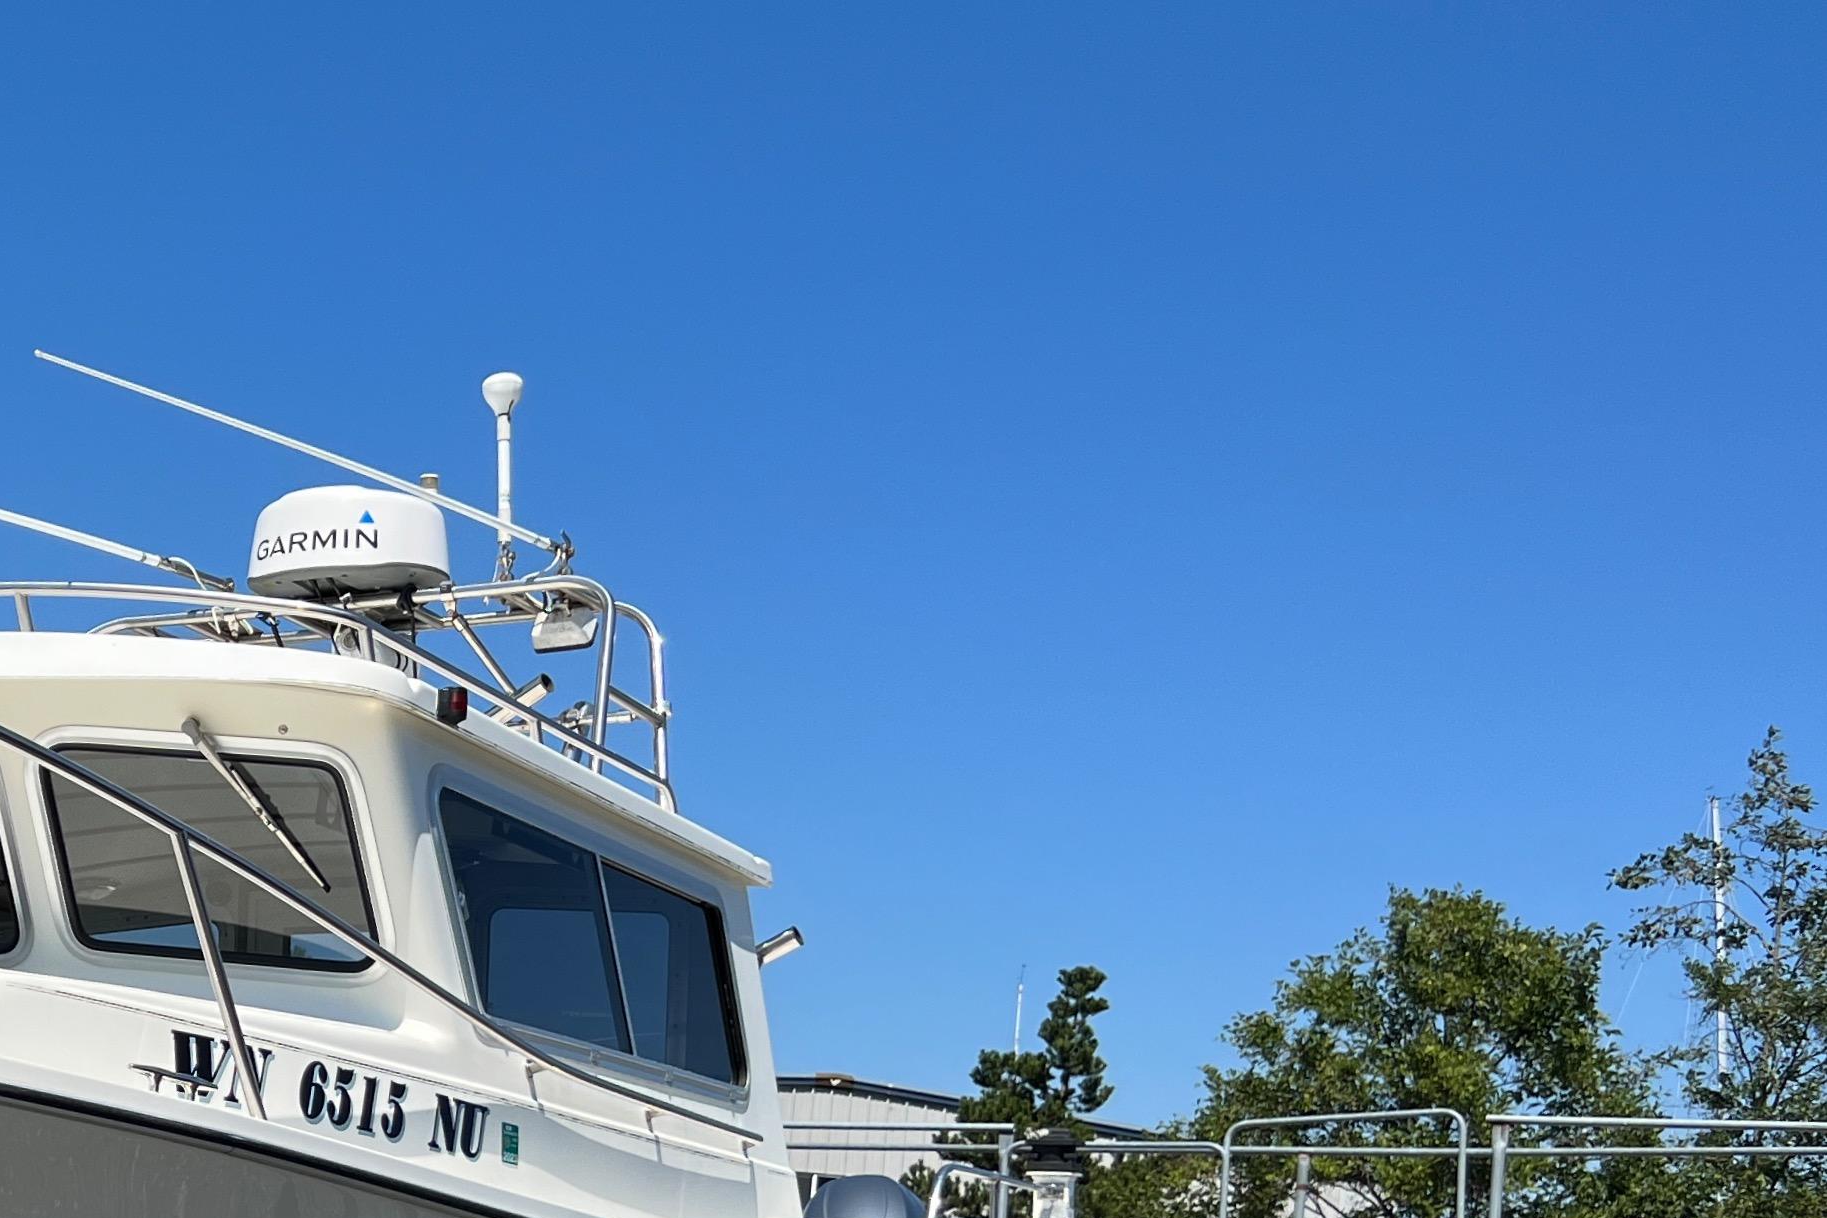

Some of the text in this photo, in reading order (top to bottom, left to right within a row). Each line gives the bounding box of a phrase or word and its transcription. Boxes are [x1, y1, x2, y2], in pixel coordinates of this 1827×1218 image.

[257, 529, 378, 561] GARMIN
[172, 1030, 491, 1162] WN 6515 NU
